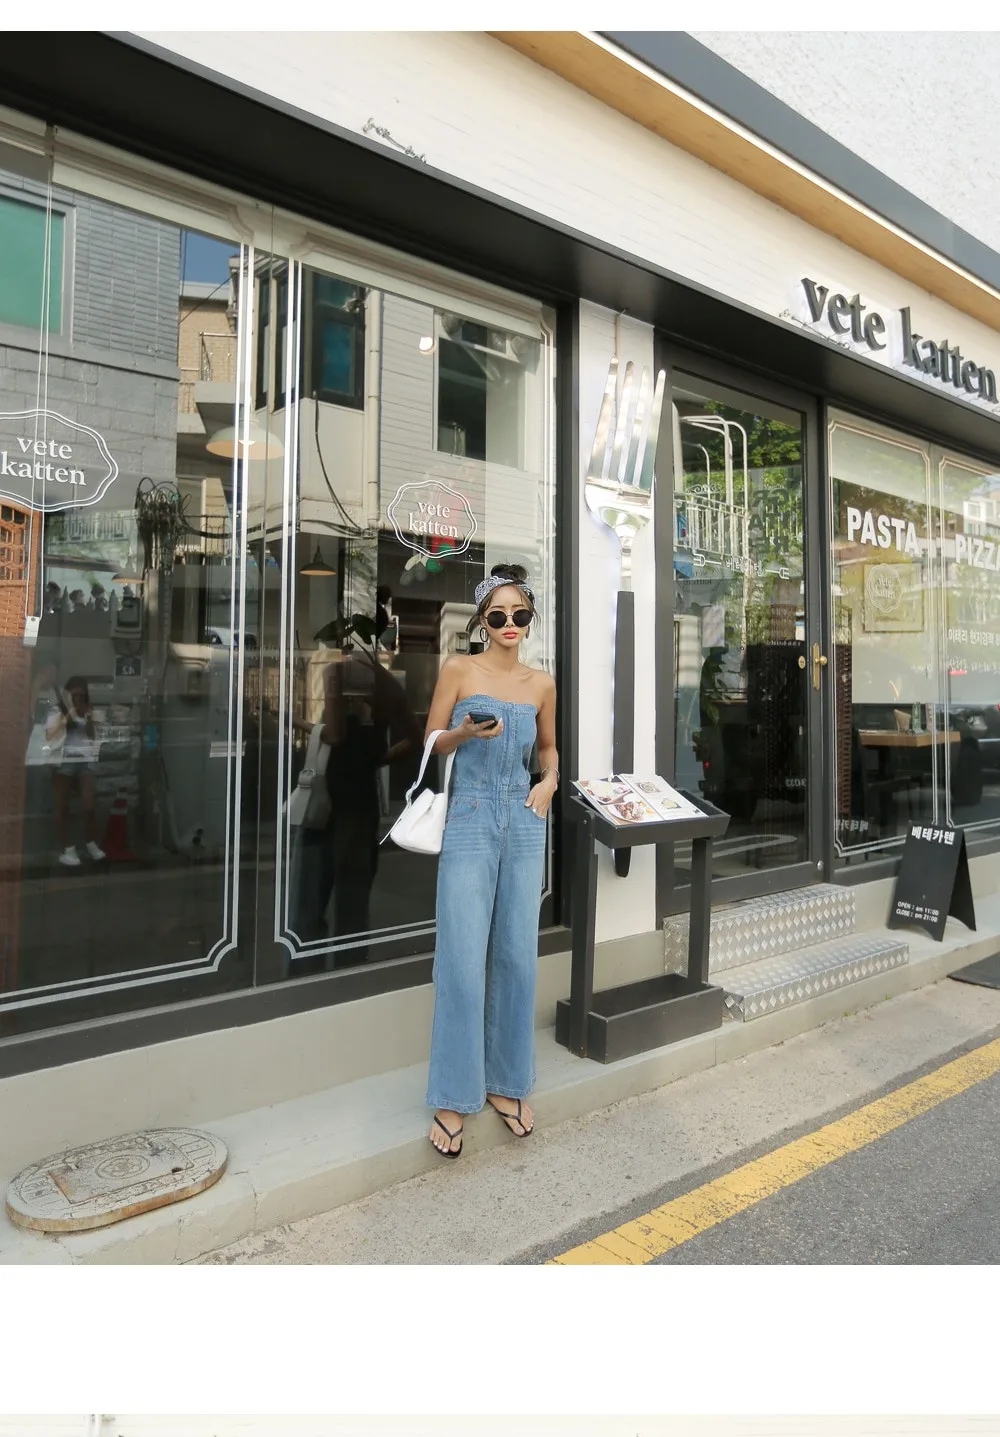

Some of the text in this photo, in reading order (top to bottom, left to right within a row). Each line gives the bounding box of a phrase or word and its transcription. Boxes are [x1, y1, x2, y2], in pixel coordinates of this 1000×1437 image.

[801, 277, 999, 404] vete katten
[17, 437, 73, 460] vete
[0, 451, 87, 486] katten
[417, 501, 451, 518] vete
[409, 512, 459, 538] katten
[847, 506, 920, 558] PASTA
[911, 825, 956, 845] 베테카텐
[896, 908, 910, 917] CLOSE
[897, 901, 911, 909] OPEN
